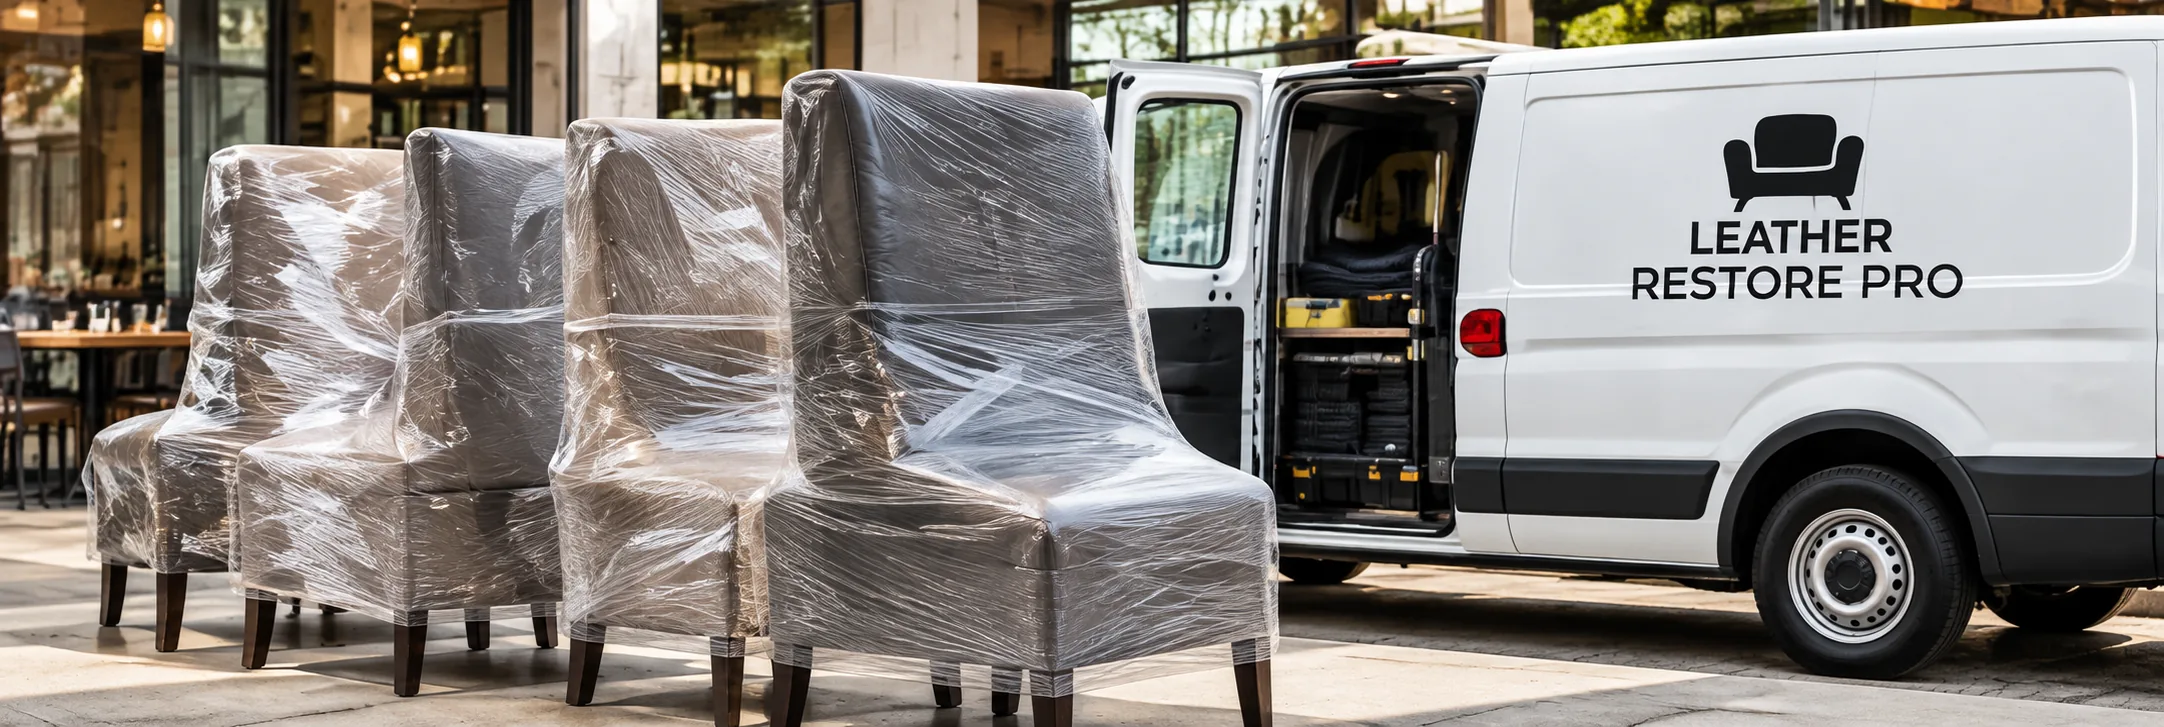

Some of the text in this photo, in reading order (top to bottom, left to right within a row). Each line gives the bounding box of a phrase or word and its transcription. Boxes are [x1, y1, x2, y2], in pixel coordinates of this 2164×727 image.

[1691, 219, 1893, 255] LEATHER
[1631, 264, 1964, 300] RESTORE PRO
